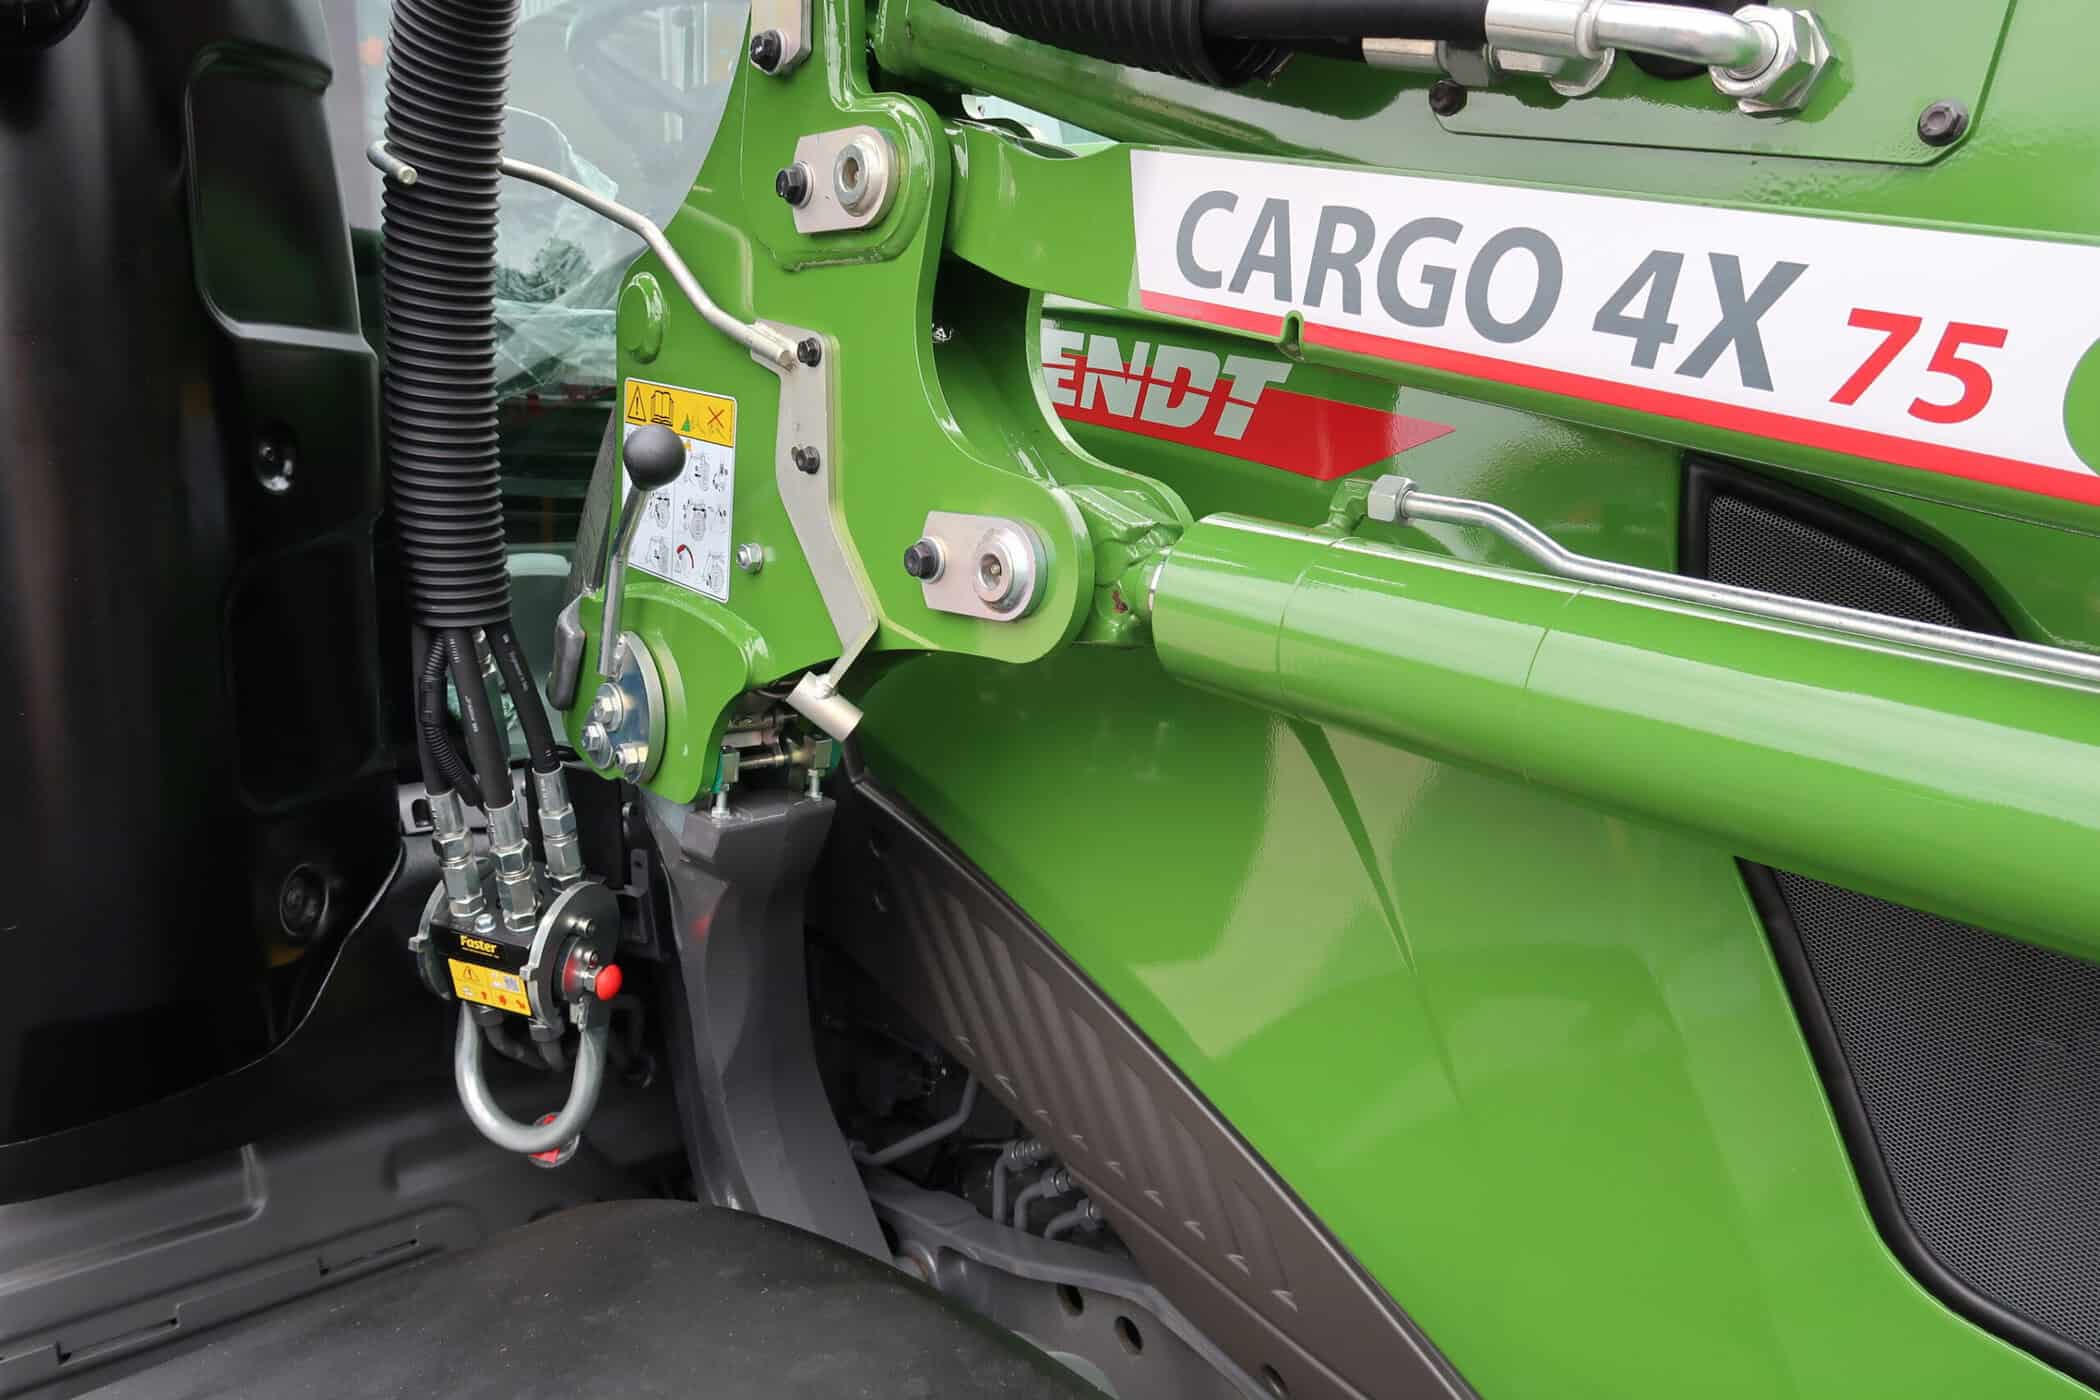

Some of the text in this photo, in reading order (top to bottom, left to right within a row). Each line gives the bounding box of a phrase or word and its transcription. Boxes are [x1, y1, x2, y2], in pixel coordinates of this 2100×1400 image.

[1176, 190, 2008, 424] CARGO 4X 75
[1039, 328, 1294, 440] ENDT
[459, 935, 498, 954] Faster
